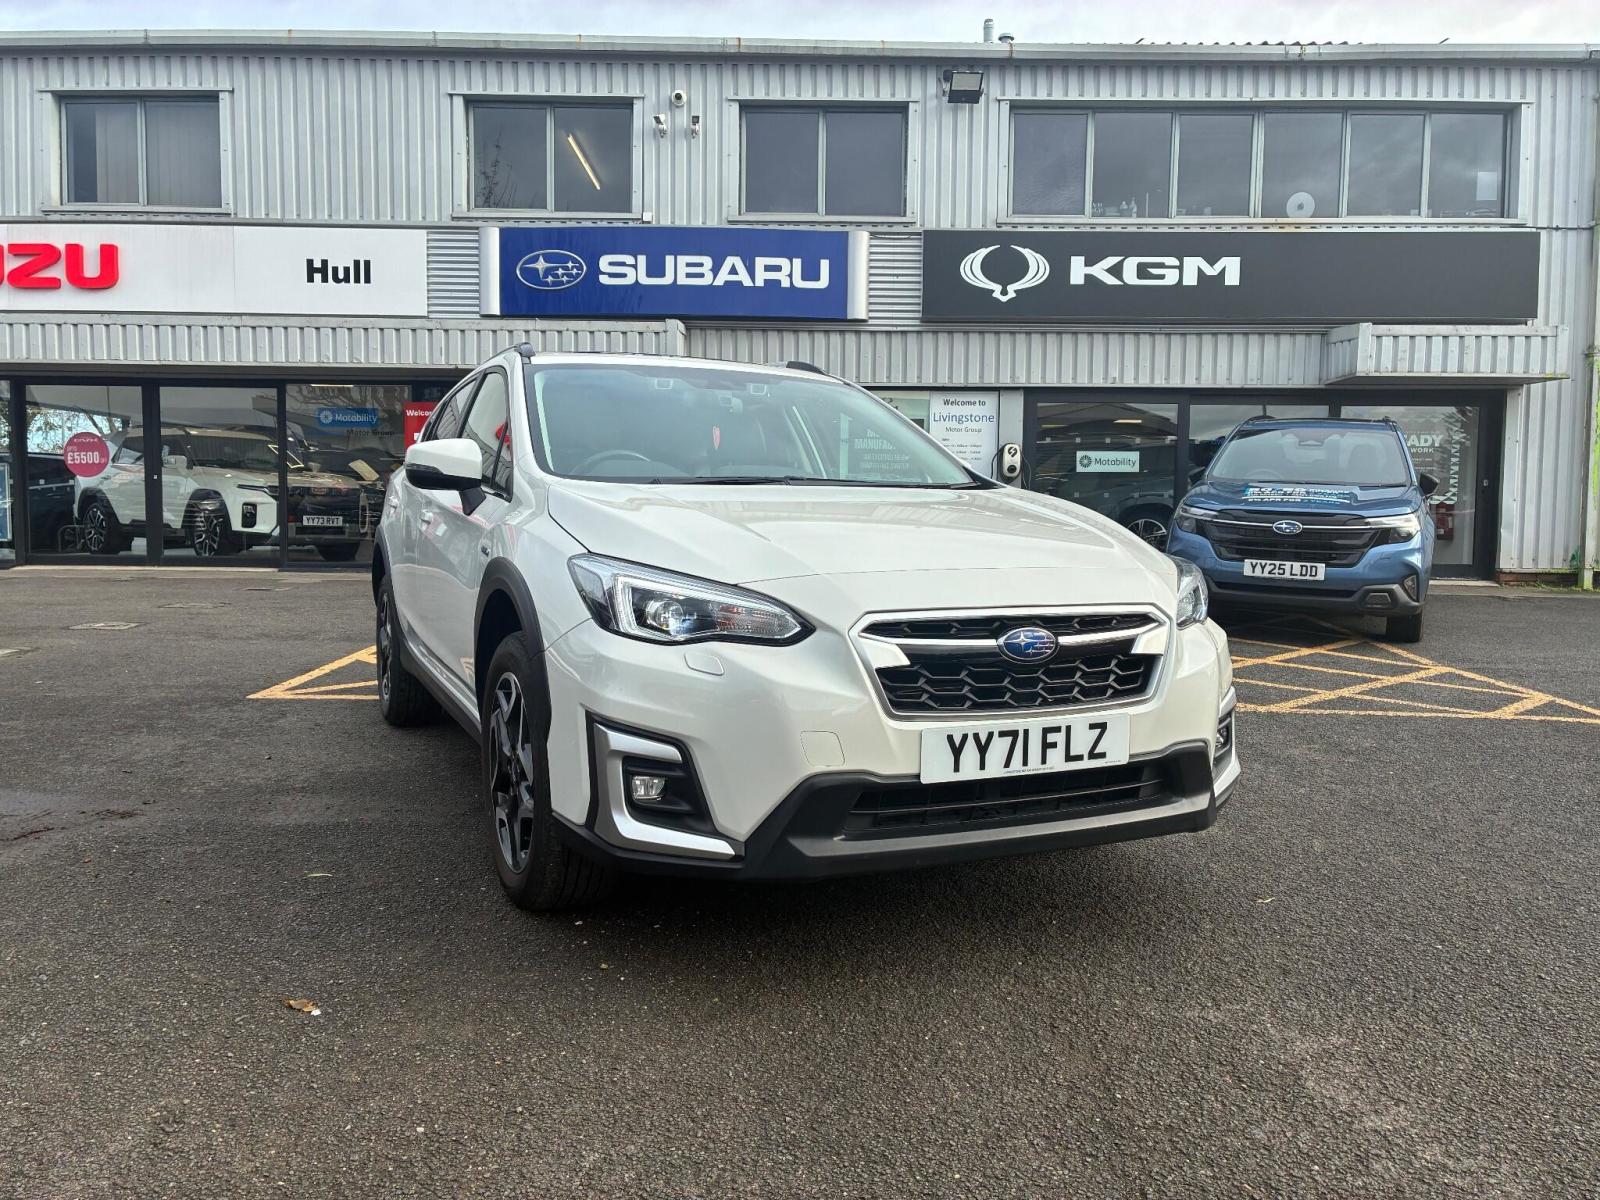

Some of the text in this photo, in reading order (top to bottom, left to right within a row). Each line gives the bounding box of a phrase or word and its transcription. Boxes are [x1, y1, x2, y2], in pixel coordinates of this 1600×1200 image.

[0, 243, 119, 289] ZU
[306, 258, 372, 284] Hull
[598, 254, 830, 289] SUBARU
[1069, 255, 1241, 286] KGM
[943, 398, 977, 406] Welcome
[335, 413, 378, 424] Motability
[406, 409, 432, 417] Welco
[933, 412, 995, 424] Livingstone
[964, 426, 982, 434] Group
[1404, 434, 1444, 447] ADY
[67, 451, 100, 464] £5500
[1094, 457, 1136, 469] Motability
[305, 516, 340, 525] YY73 RVT
[1250, 561, 1318, 578] YY25 LDD
[946, 721, 1108, 773] YY71 FLZ
